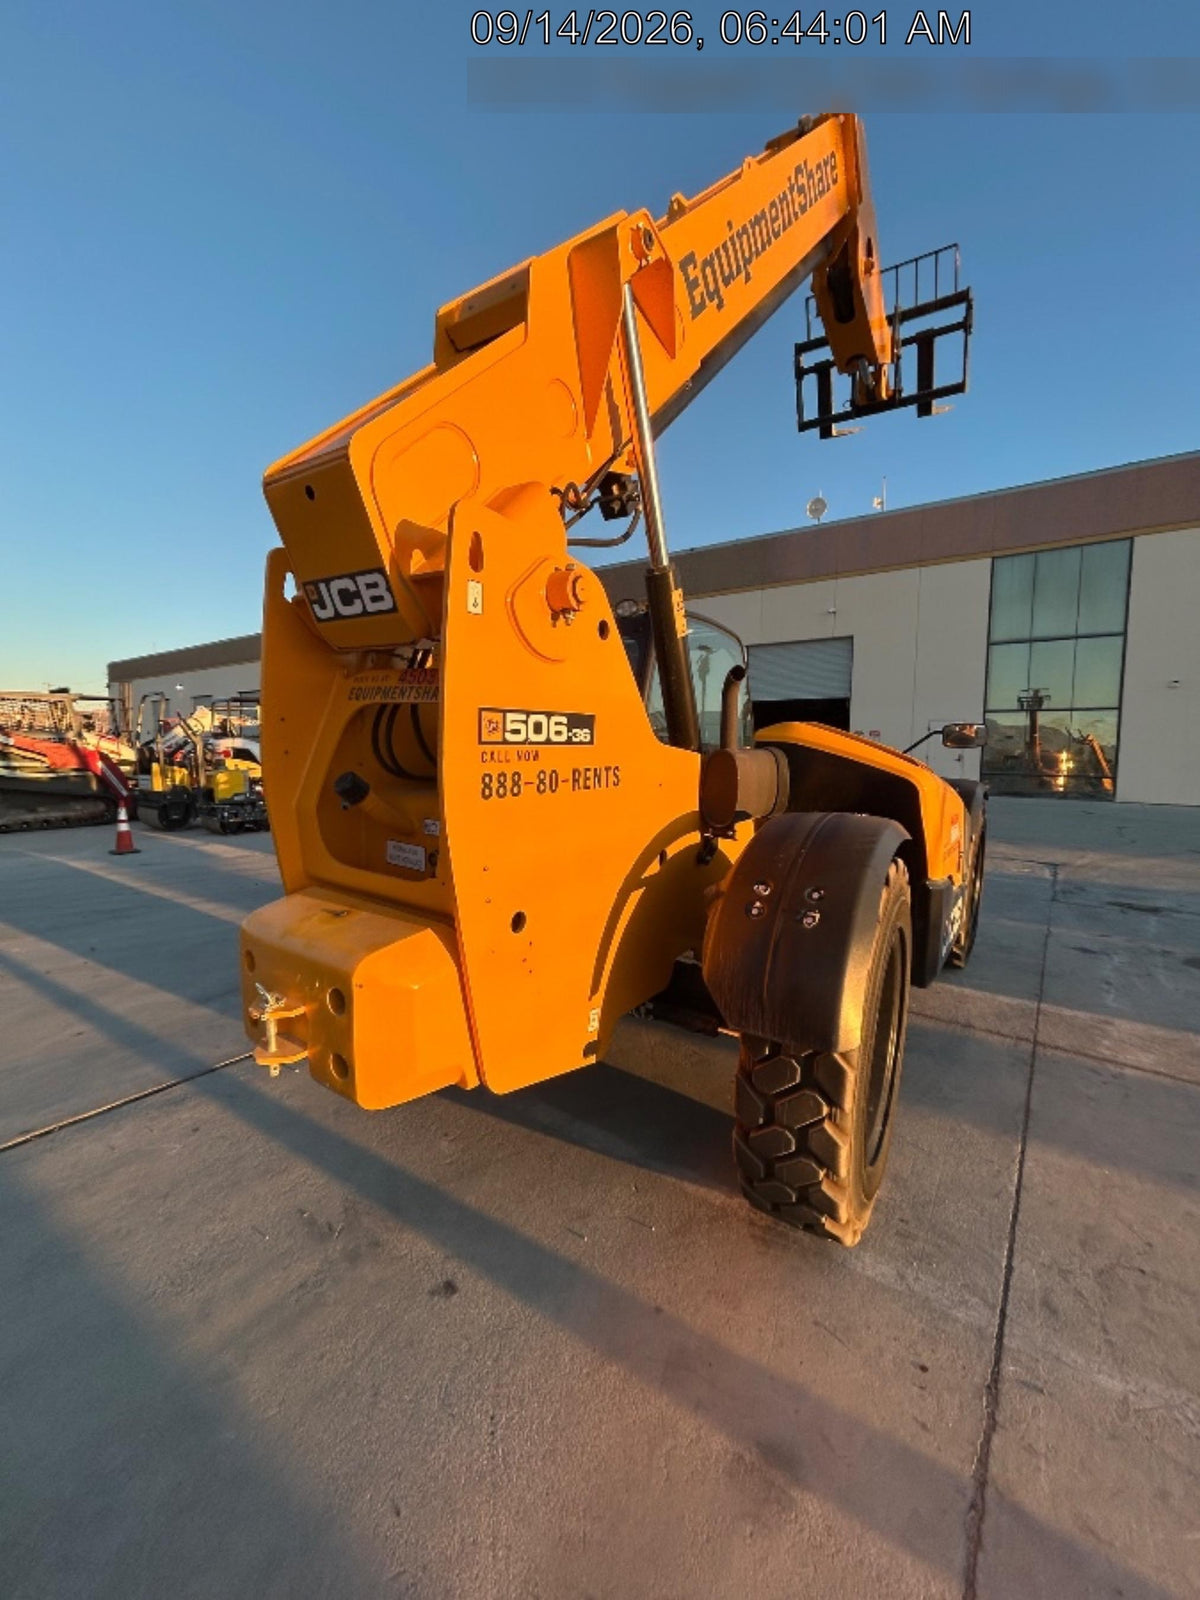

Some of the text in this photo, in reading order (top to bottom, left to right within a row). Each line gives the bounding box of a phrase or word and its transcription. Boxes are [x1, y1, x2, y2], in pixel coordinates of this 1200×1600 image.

[678, 150, 838, 320] EquipmentShare
[311, 571, 394, 620] JCB
[481, 750, 540, 763] CALL NOW
[480, 766, 621, 800] 888-80-RENTS
